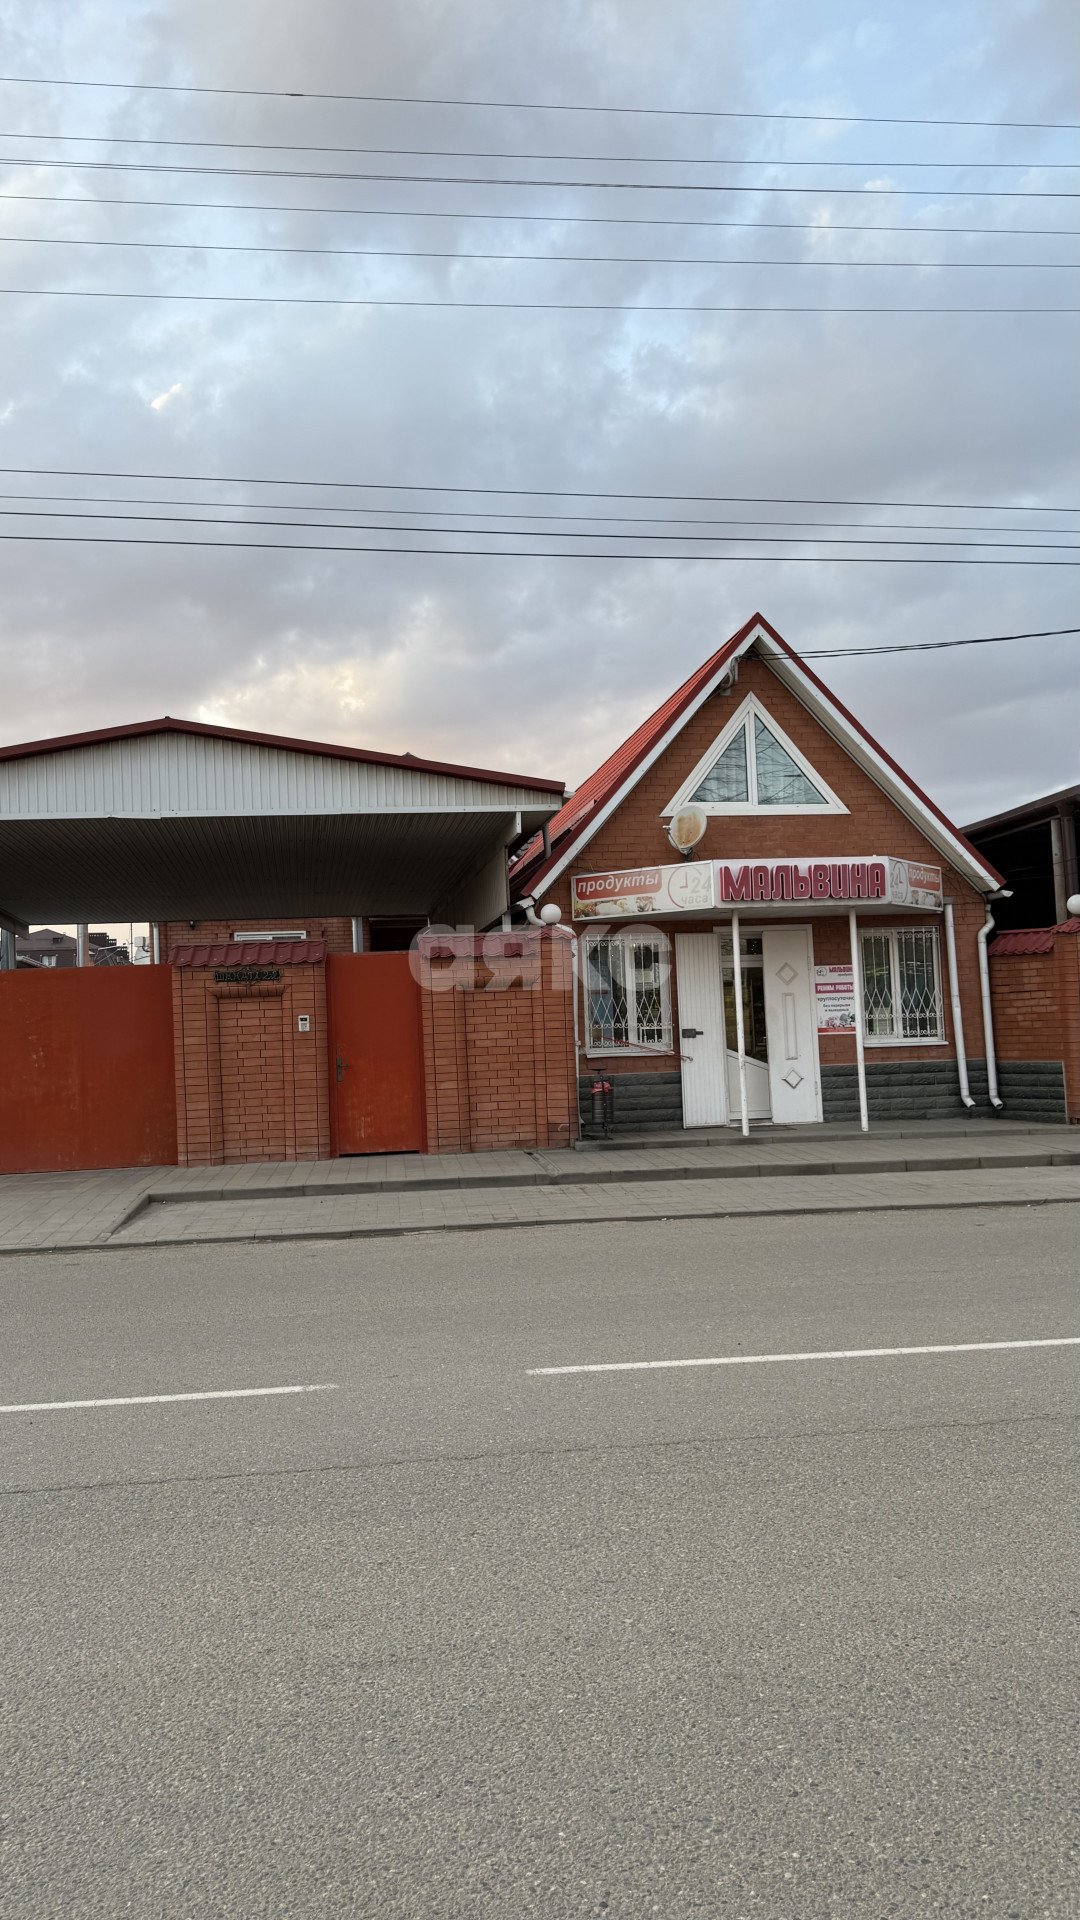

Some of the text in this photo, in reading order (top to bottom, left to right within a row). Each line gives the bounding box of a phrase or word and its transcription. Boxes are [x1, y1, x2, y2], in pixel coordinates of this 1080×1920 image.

[577, 874, 658, 895] продукты
[690, 875, 711, 894] 24
[721, 863, 885, 900] МАЛЬВИНА
[909, 867, 940, 884] продукты
[681, 894, 708, 905] часа
